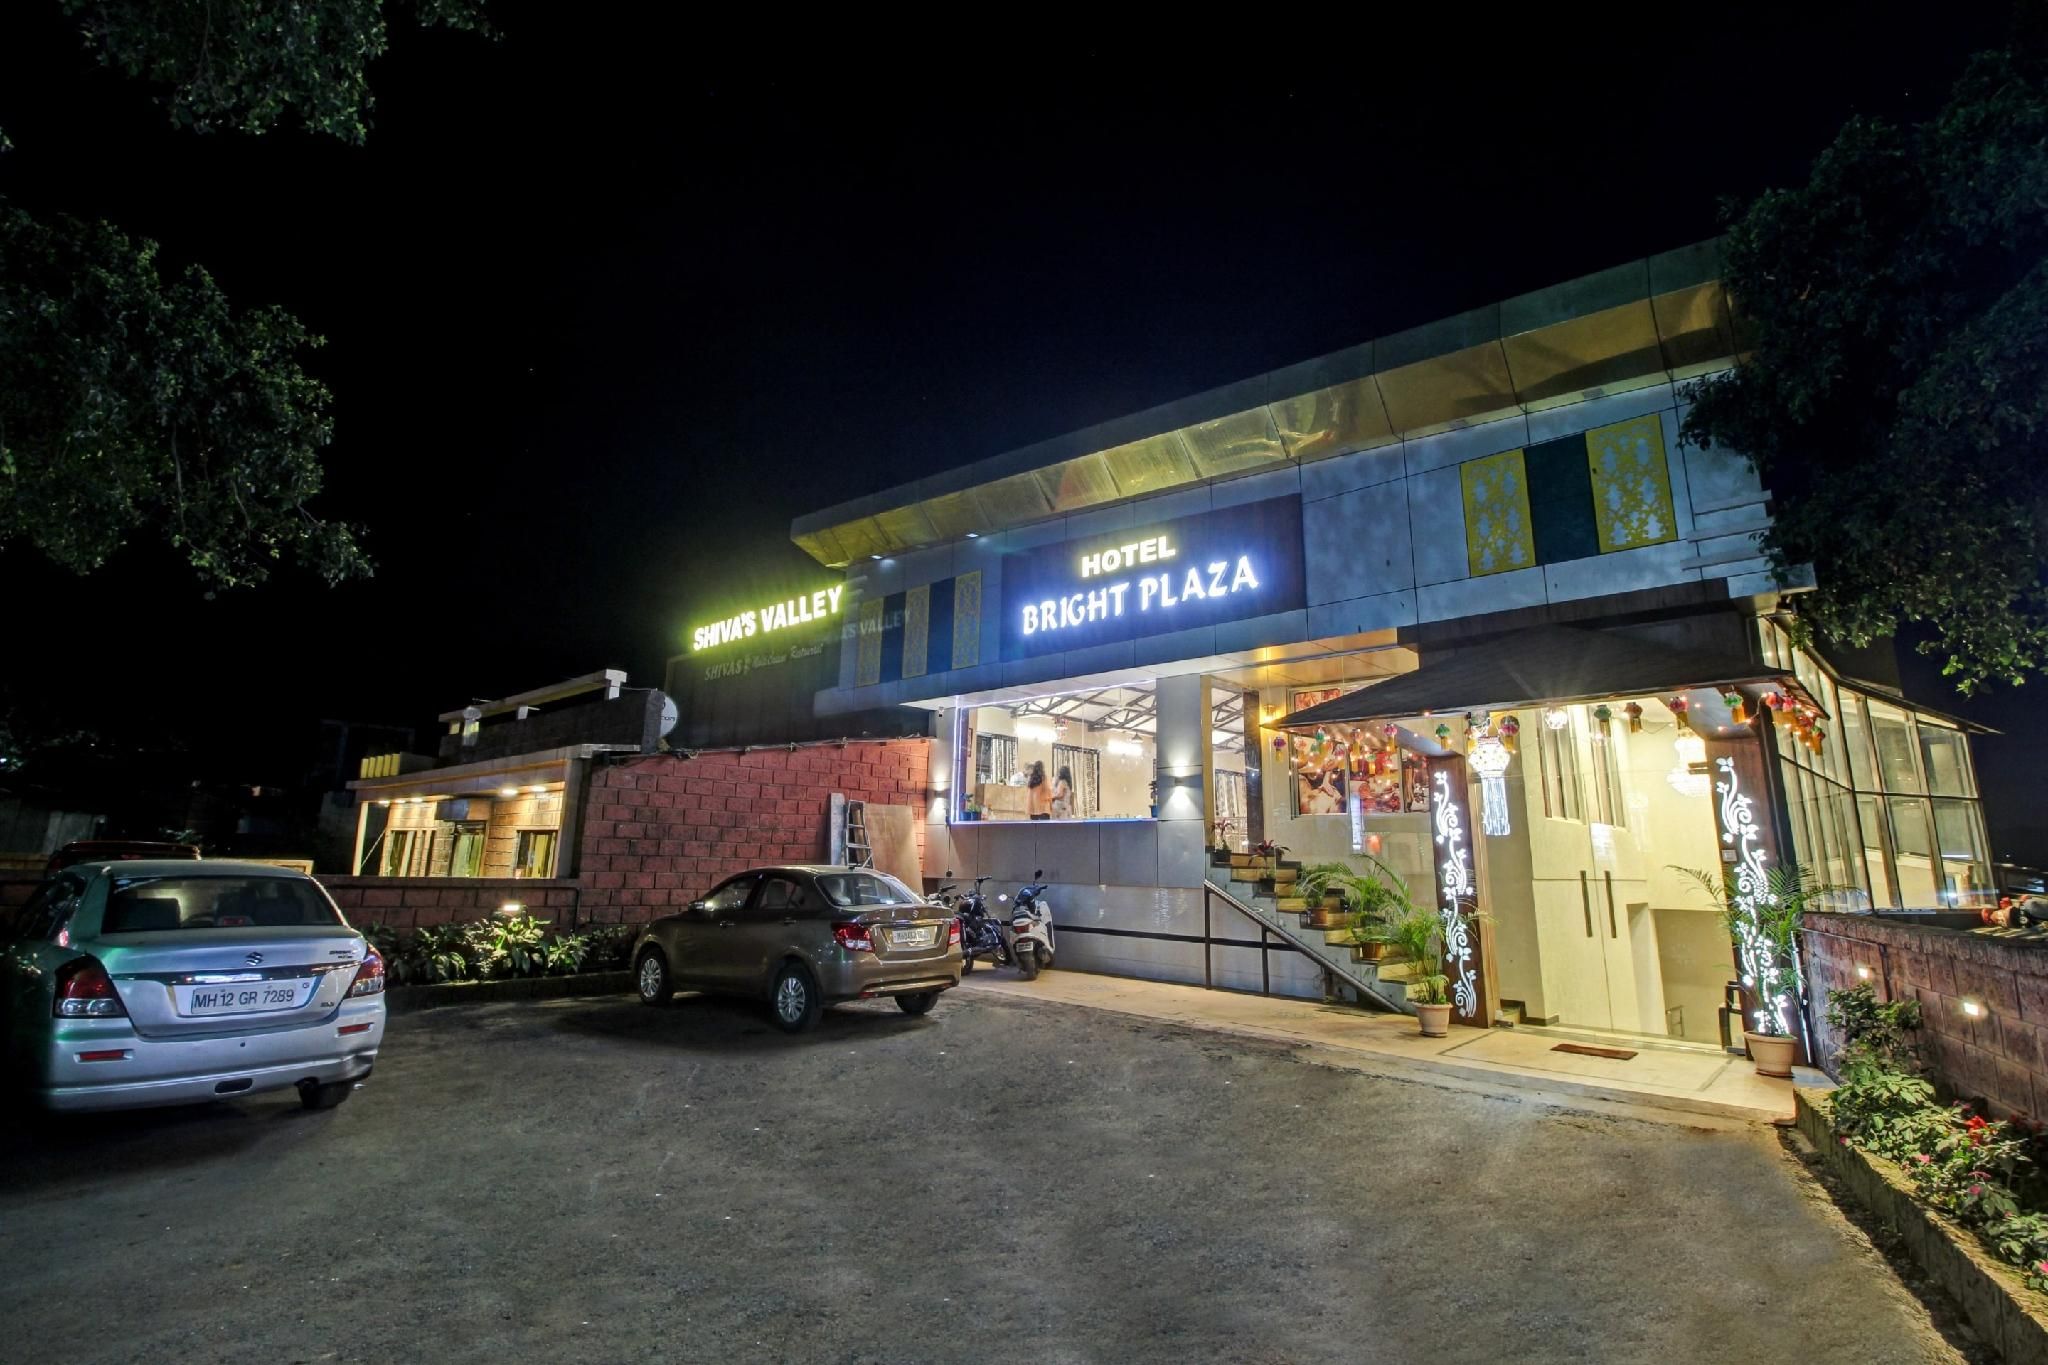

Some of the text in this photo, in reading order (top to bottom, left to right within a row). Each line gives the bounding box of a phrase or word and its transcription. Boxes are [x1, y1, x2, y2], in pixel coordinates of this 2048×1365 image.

[1081, 536, 1176, 578] HOTEL
[693, 610, 757, 650] SHIVA'S
[761, 585, 843, 632] VALLEY
[1022, 555, 1259, 635] BRIGHT PLAZA
[194, 989, 295, 1008] MH 12 GR 7289
